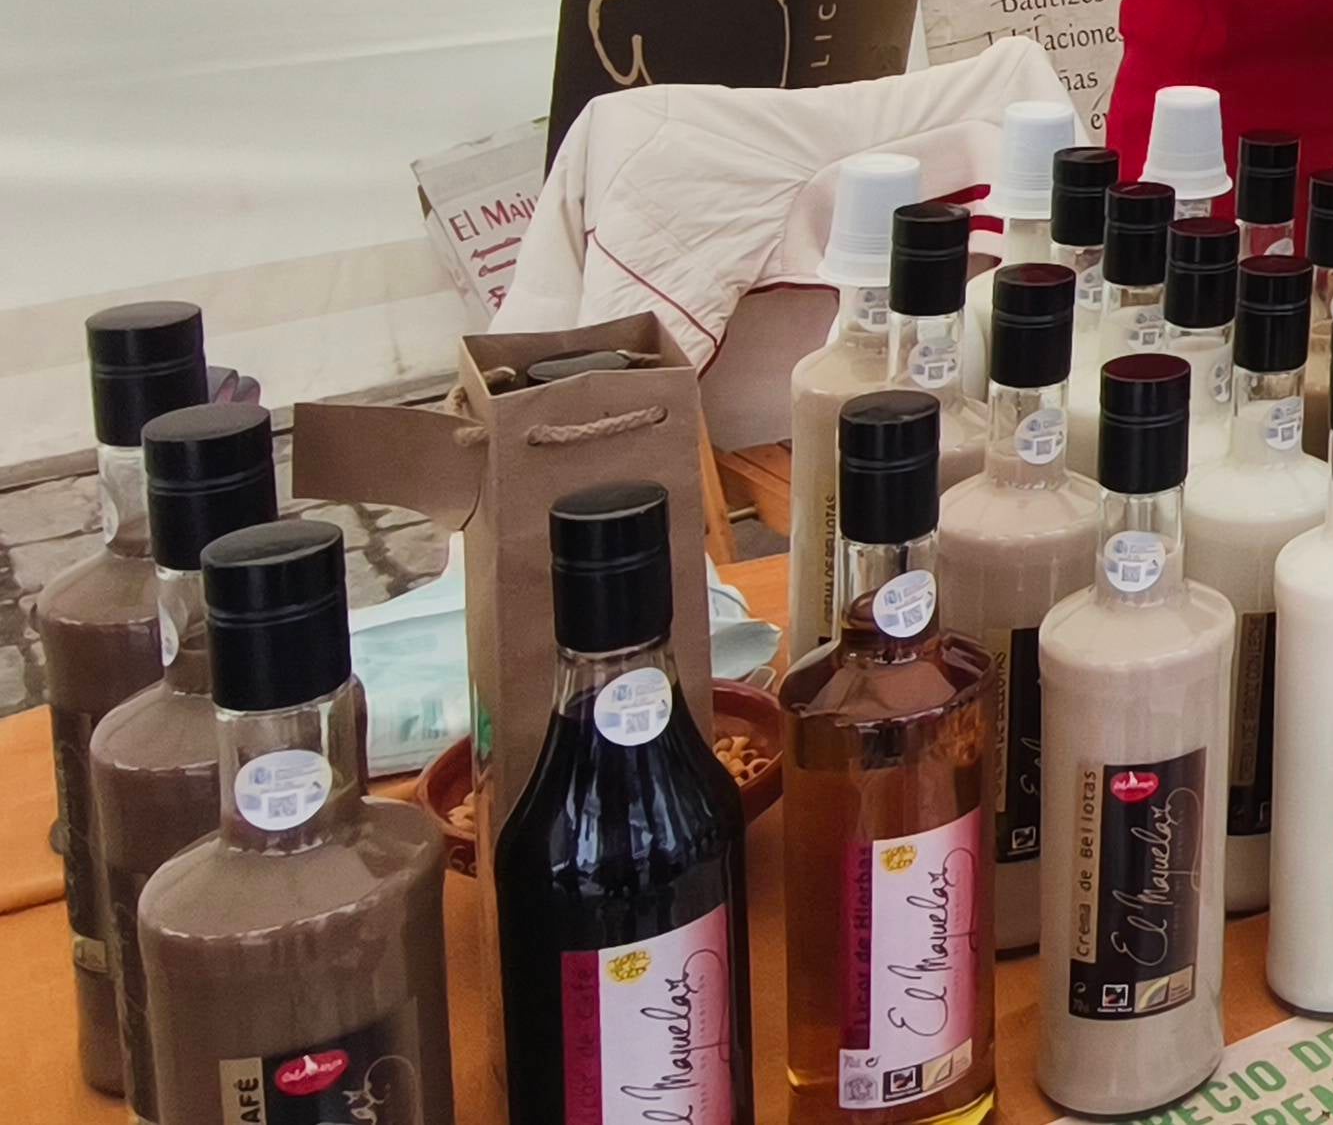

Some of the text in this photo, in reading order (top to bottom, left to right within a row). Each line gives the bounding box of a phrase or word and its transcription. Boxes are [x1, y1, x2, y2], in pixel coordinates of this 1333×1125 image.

[449, 210, 481, 242] El
[1076, 770, 1097, 957] Crema de Bellotas
[1111, 916, 1167, 967] El
[888, 985, 949, 1037] El
